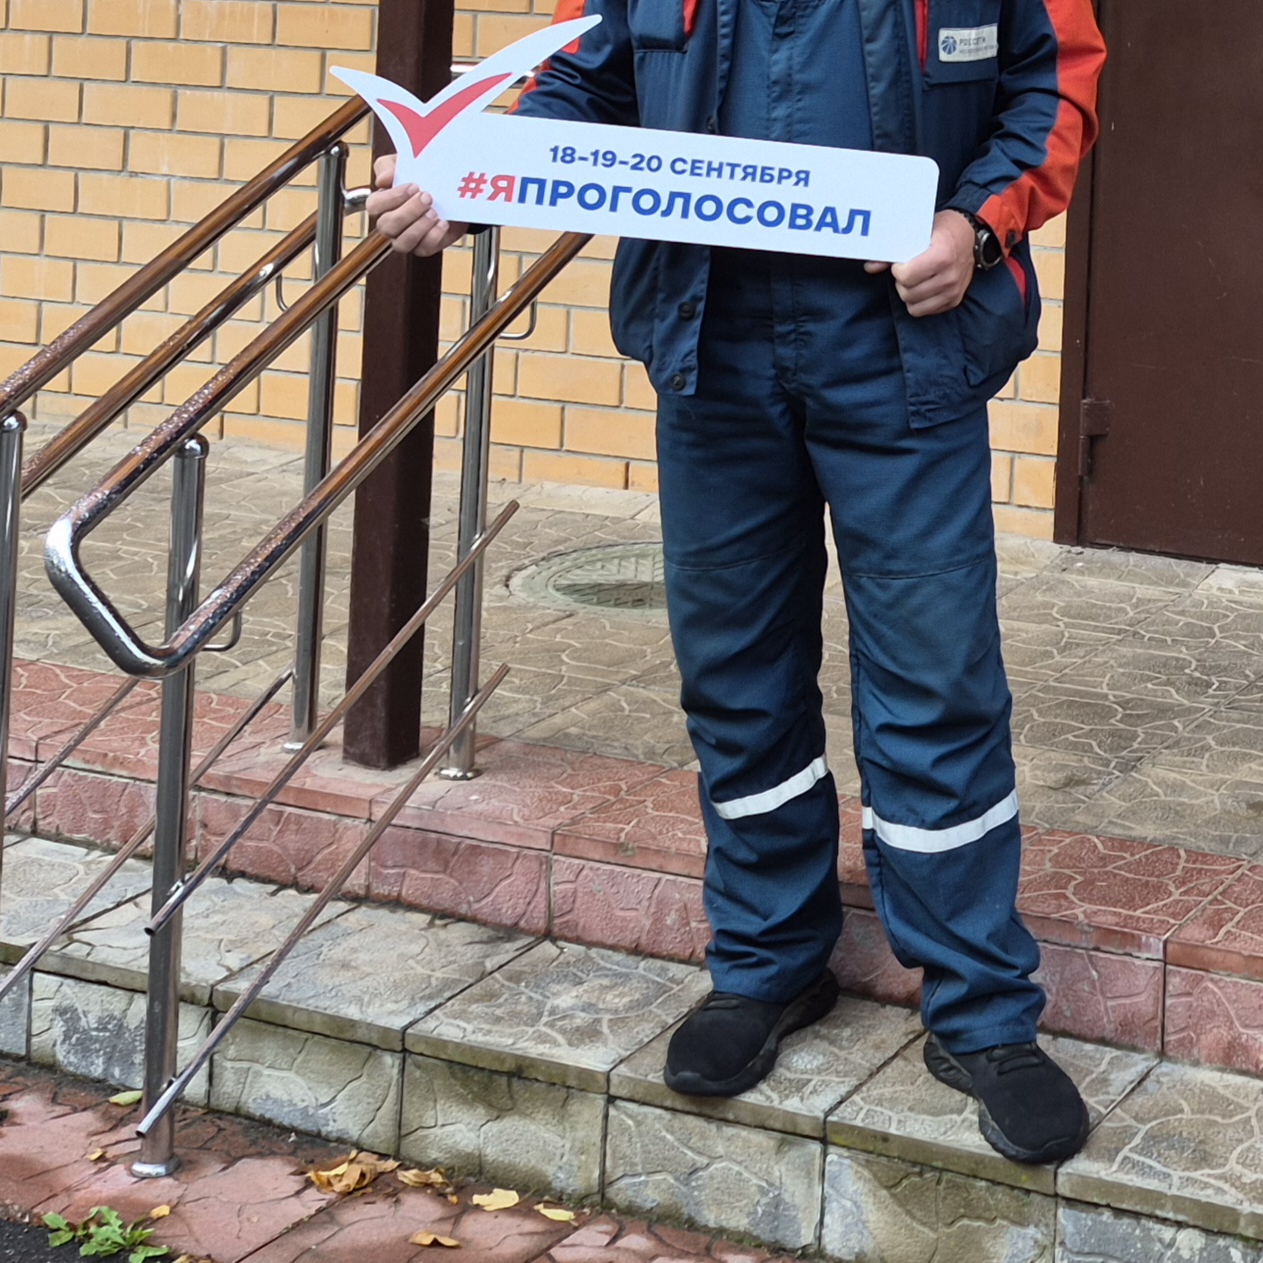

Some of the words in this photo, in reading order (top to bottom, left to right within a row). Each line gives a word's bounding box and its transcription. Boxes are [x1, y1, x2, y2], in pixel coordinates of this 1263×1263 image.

[548, 143, 663, 174] 18-19-20
[669, 157, 811, 189] СЕНТЯБРЯ
[456, 170, 872, 237] #ЯПРОГОЛОСОВАЛ
